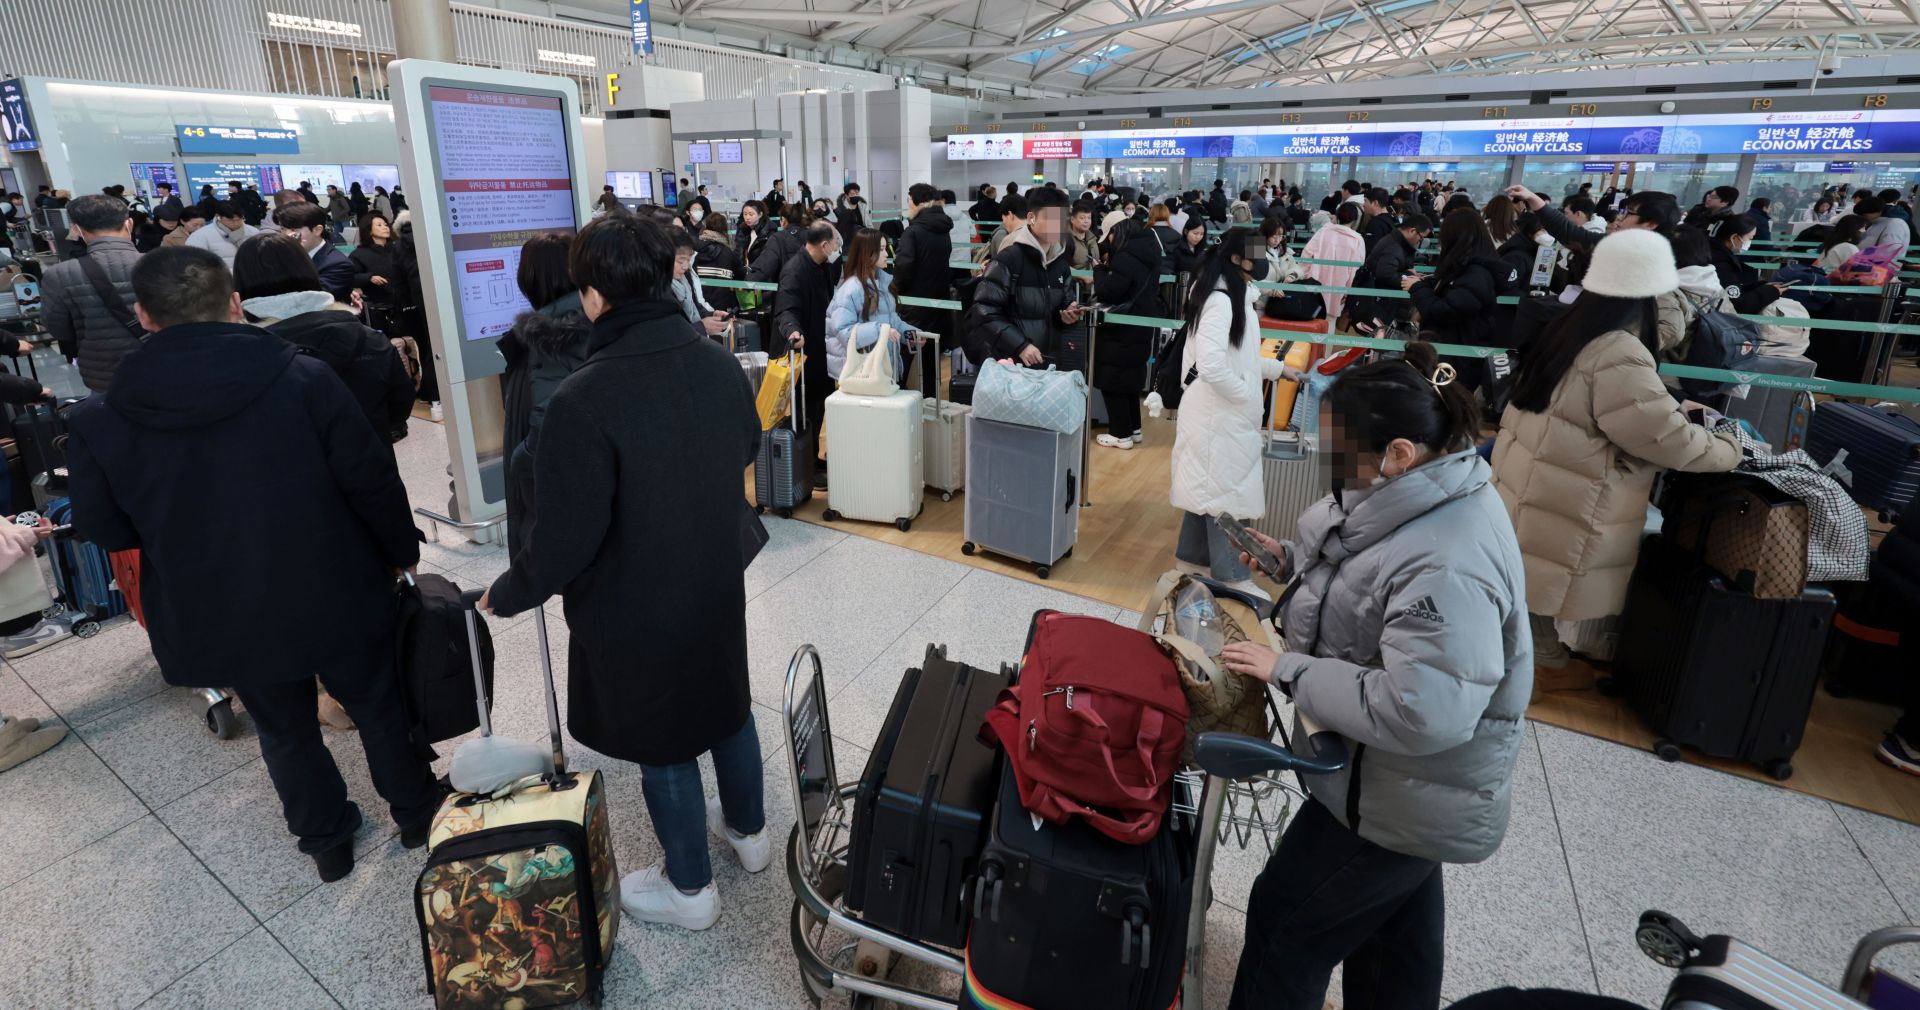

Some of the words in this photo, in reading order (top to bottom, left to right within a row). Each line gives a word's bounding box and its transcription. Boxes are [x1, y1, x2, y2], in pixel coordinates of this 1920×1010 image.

[607, 73, 620, 105] F
[1752, 98, 1772, 110] F9
[1863, 94, 1888, 108] F8
[1484, 107, 1508, 118] F11
[1570, 104, 1596, 116] F10
[1174, 118, 1191, 126] F14
[1282, 114, 1302, 122] F13
[1348, 112, 1368, 121] F12
[1120, 120, 1136, 128] F15
[184, 127, 205, 138] 4-6
[1495, 132, 1528, 144] 일반석
[1532, 132, 1569, 142] 经济舱
[1758, 128, 1799, 140] 일반석
[1806, 126, 1855, 139] 经济舱
[1129, 140, 1150, 148] 일반석
[1152, 140, 1176, 148] 经济舱
[1291, 137, 1318, 146] 일반석
[1320, 136, 1350, 146] 经济舱
[1743, 140, 1818, 151] ECONOMY
[1822, 139, 1872, 150] CLASS
[1283, 146, 1330, 154] ECONOMY
[1330, 146, 1360, 154] CLASS
[1484, 144, 1542, 152] ECONOMY
[1544, 142, 1582, 152] CLASS
[1758, 378, 1792, 387] Incheon
[1794, 382, 1826, 390] Airport
[1404, 608, 1444, 623] adidas
